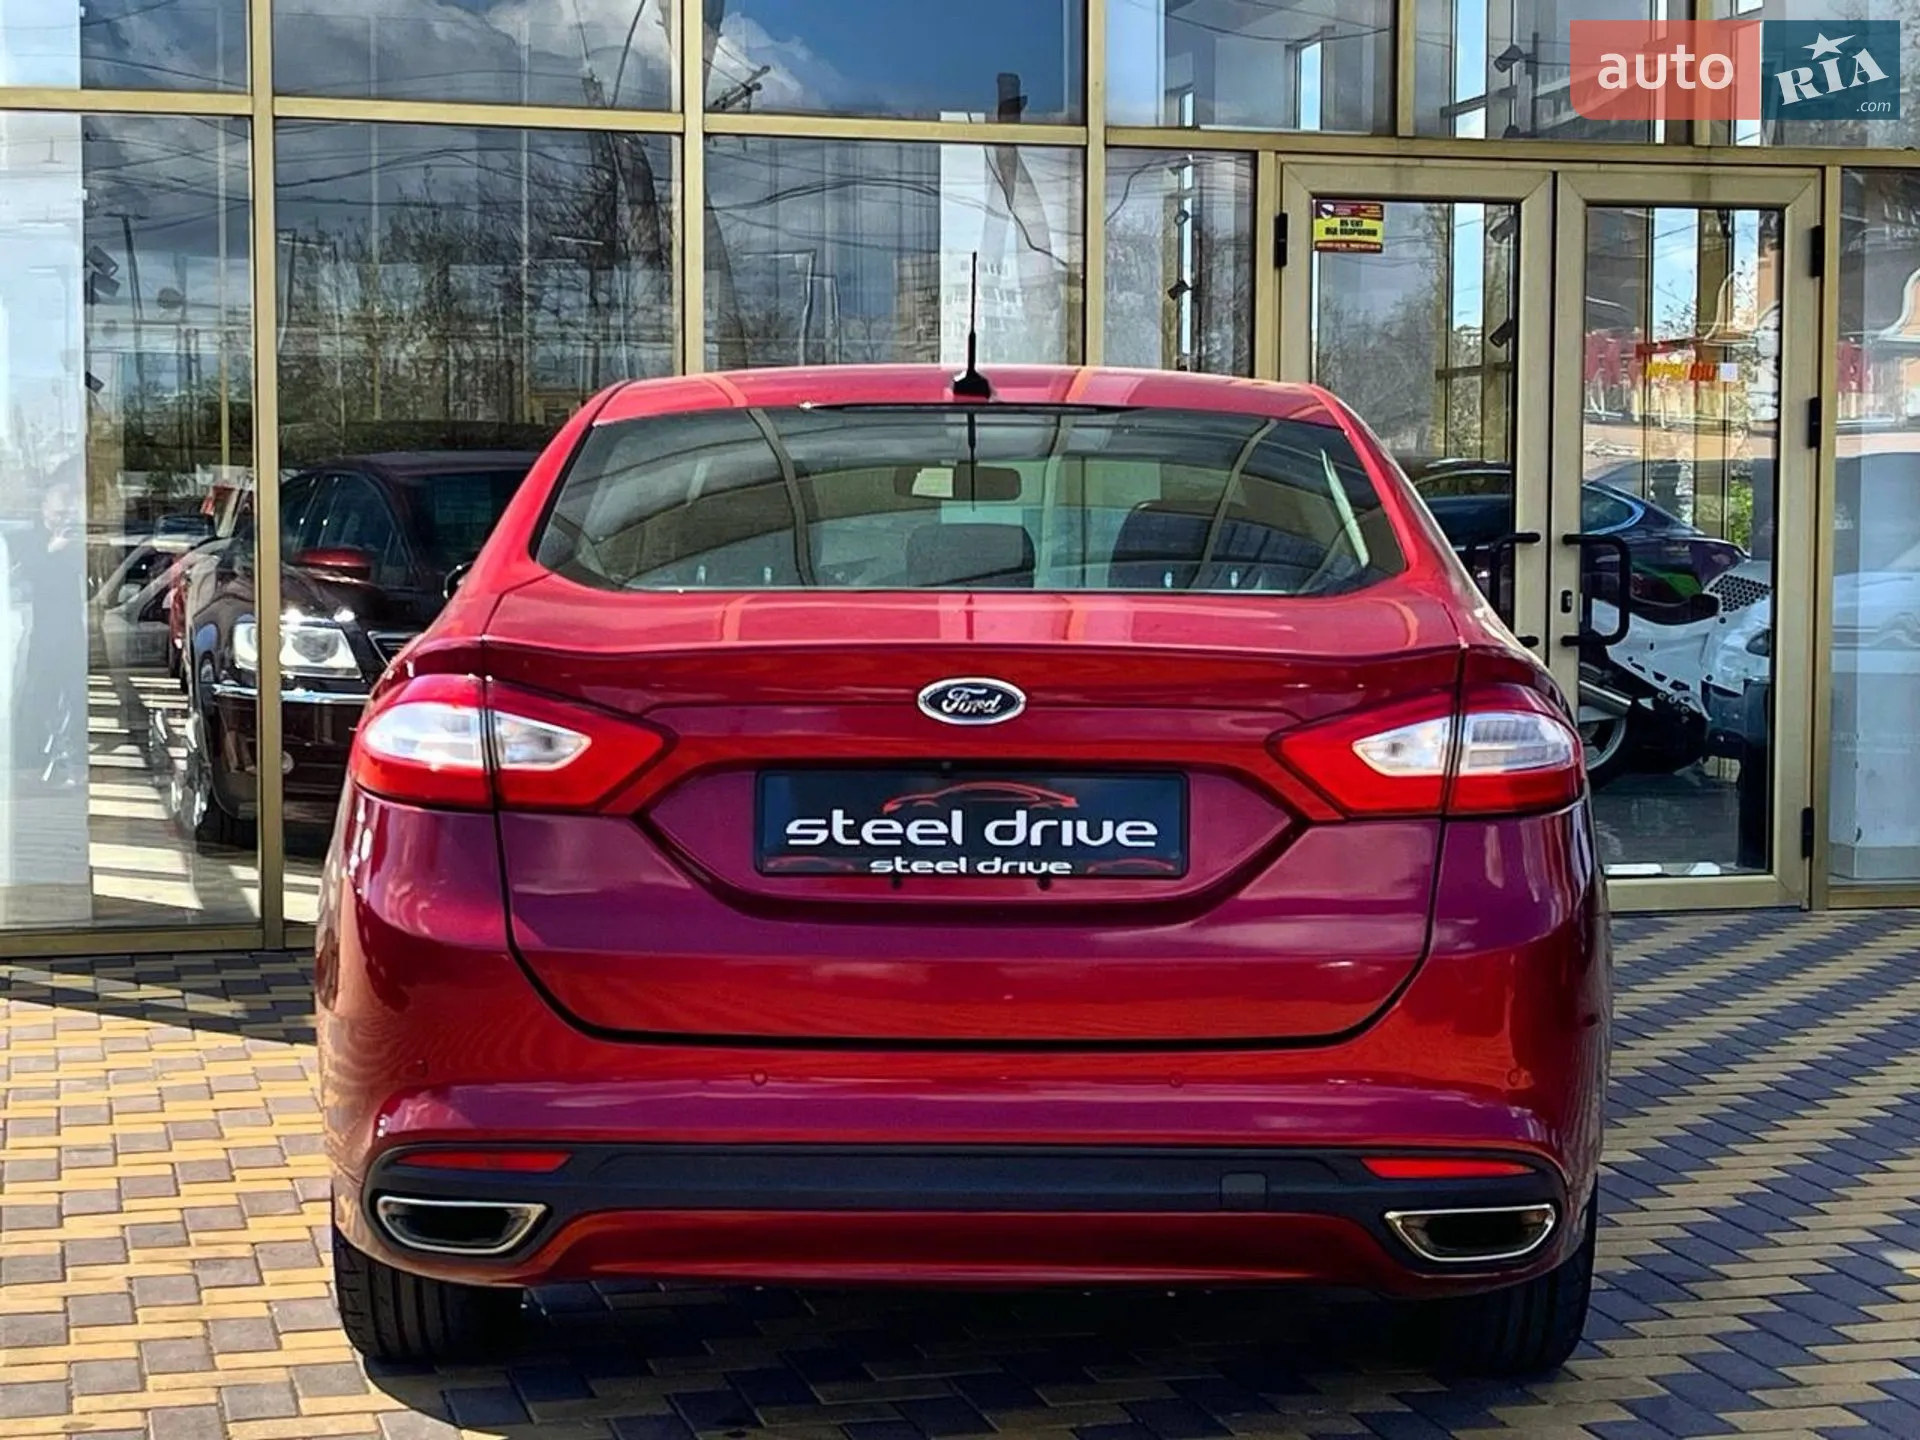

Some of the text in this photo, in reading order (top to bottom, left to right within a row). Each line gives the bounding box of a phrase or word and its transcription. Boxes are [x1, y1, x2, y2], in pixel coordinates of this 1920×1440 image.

[941, 687, 1003, 713] Ford
[786, 809, 1158, 847] steel drive
[870, 857, 1073, 875] steel drive
